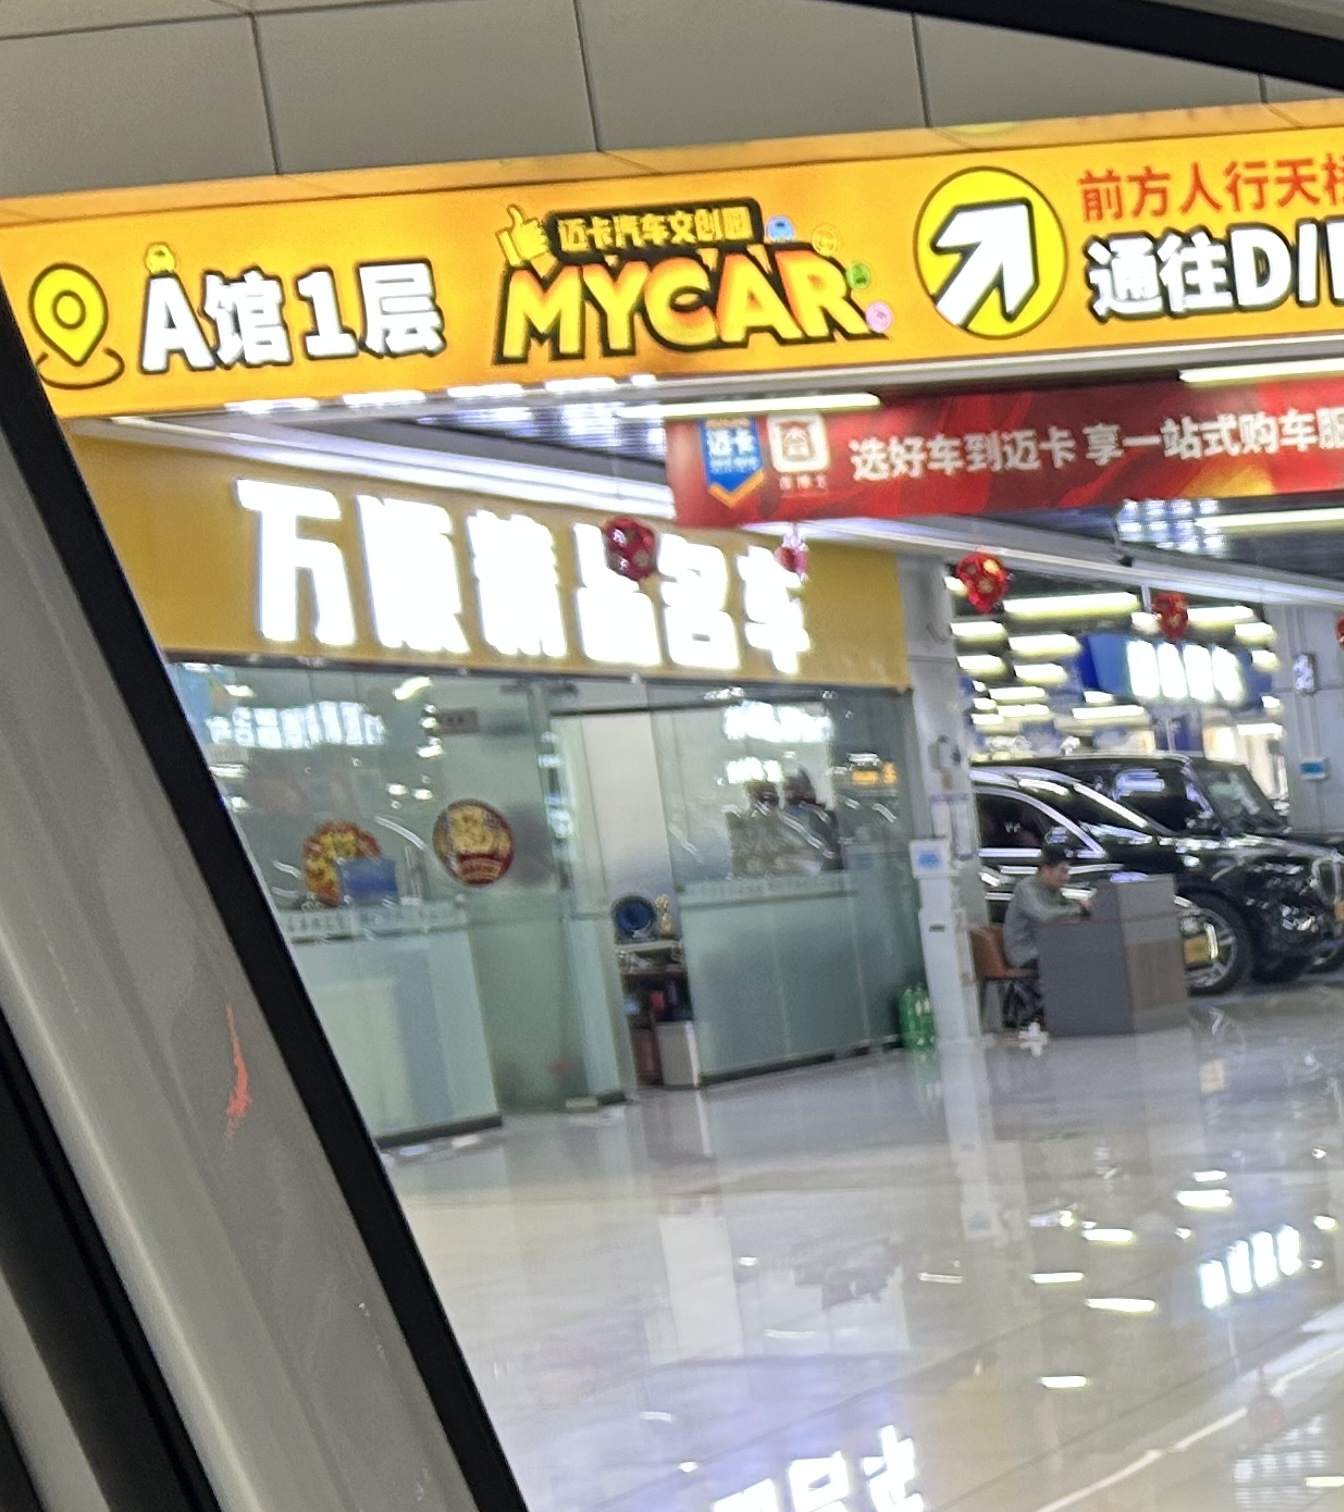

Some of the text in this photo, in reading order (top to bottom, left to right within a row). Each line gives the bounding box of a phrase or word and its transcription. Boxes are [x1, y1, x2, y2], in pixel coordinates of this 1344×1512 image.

[557, 206, 753, 252] 迈卡汽车文创园
[141, 259, 446, 374] A馆1层
[495, 246, 882, 364] MYCAR
[849, 424, 1076, 481] 选好车到迈卡
